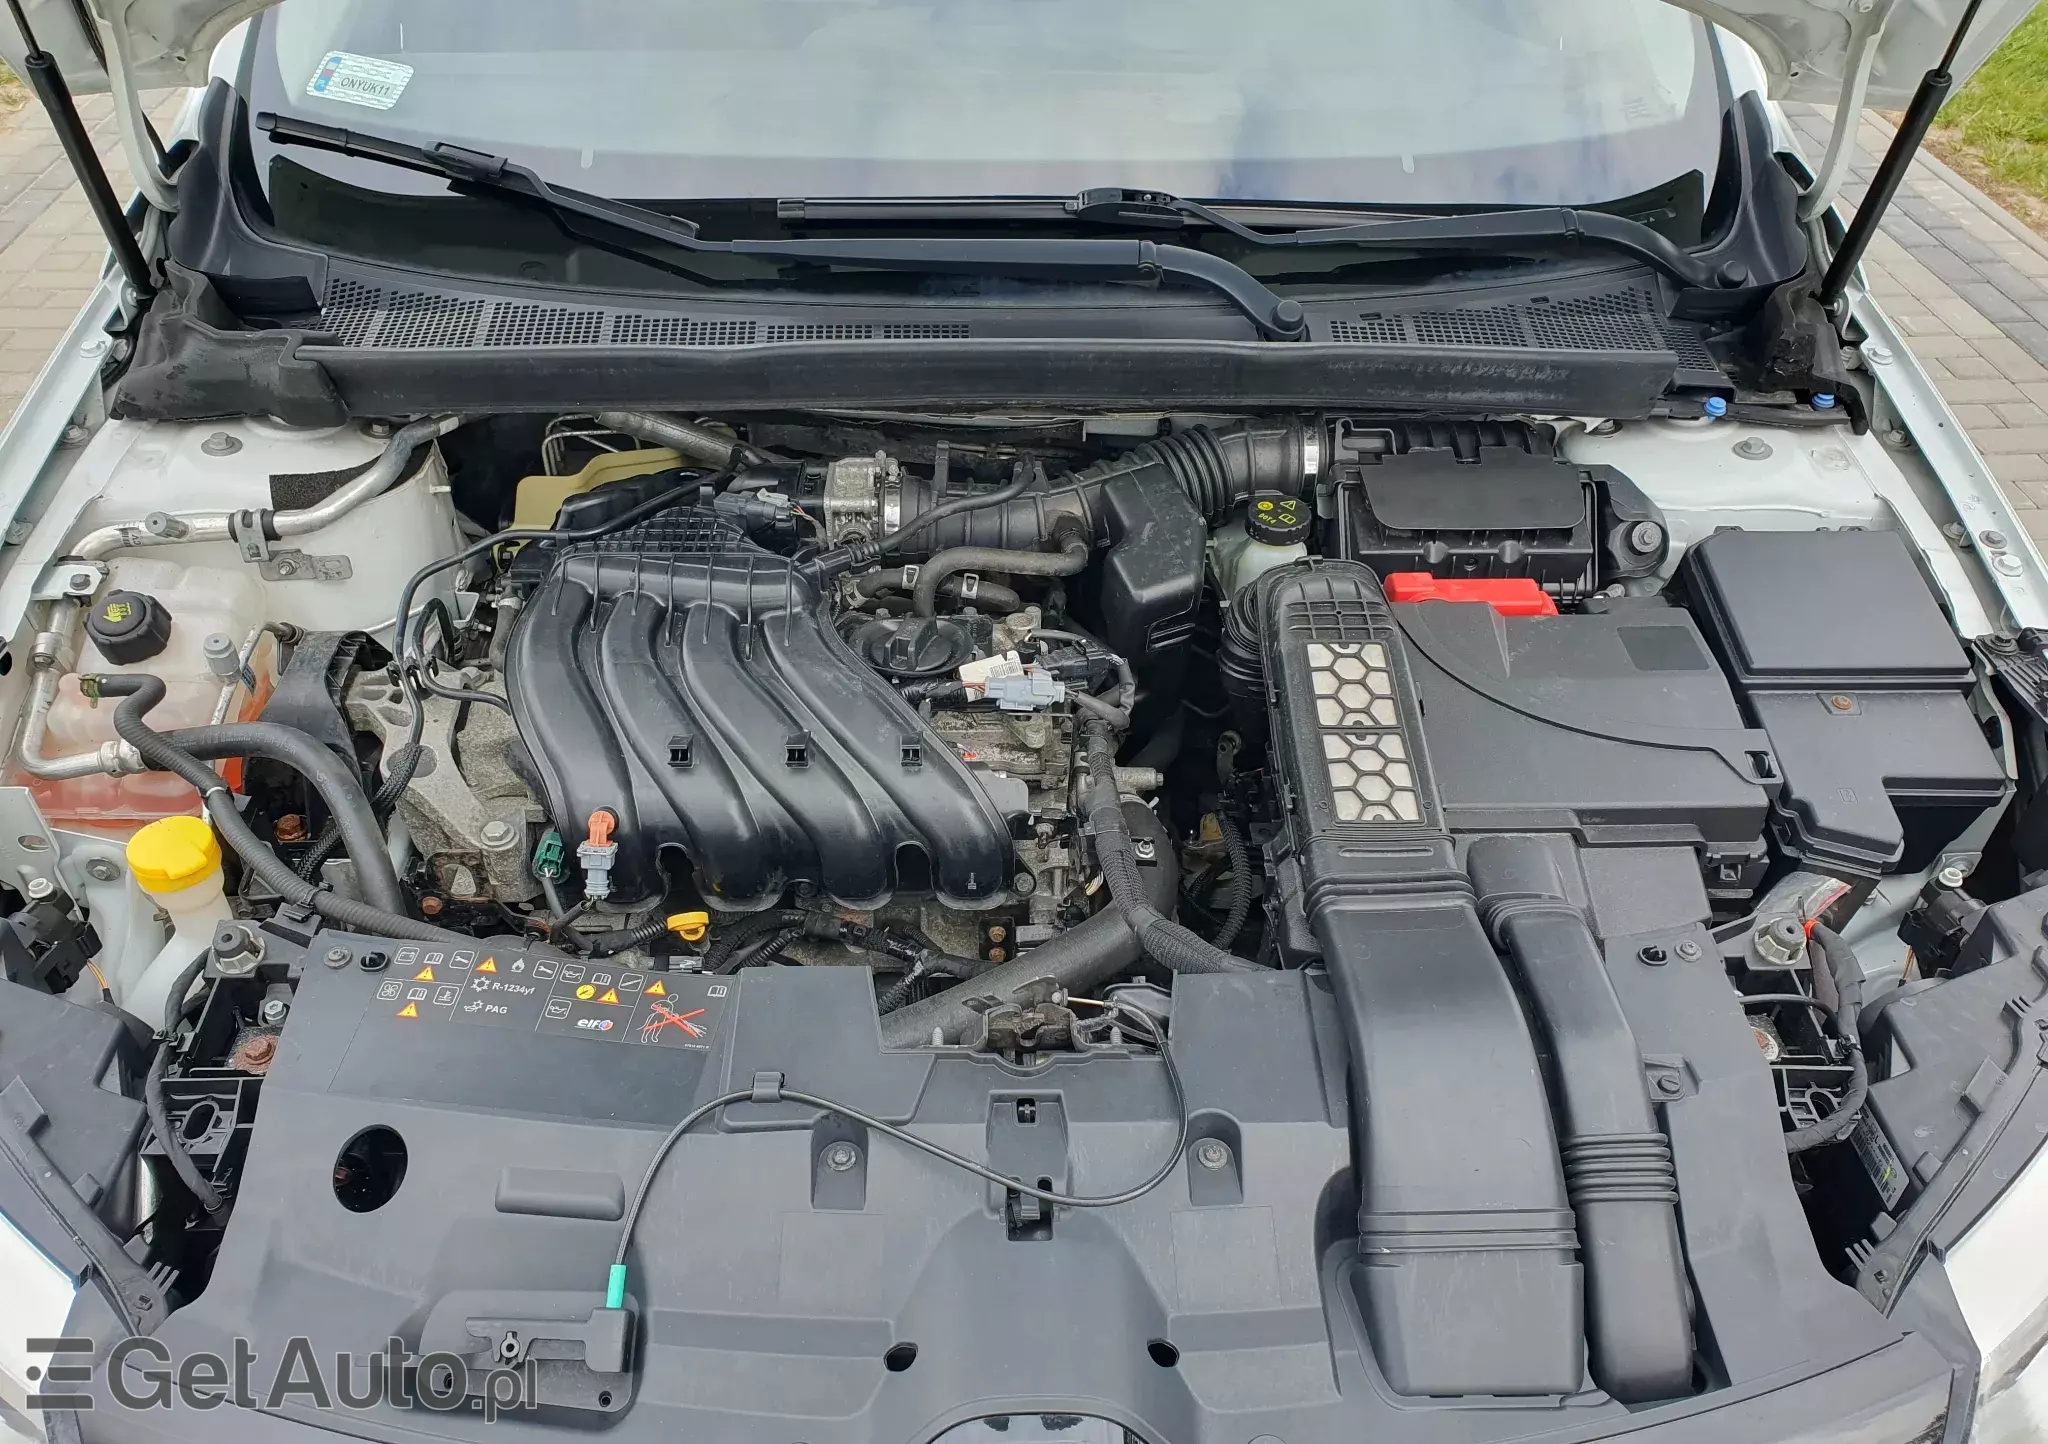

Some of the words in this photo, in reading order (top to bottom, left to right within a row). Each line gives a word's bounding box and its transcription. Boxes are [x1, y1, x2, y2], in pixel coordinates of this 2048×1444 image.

[341, 77, 390, 96] ONYUK11
[492, 982, 536, 996] R-1234yf
[484, 1004, 508, 1014] PAG
[577, 1018, 601, 1028] elf
